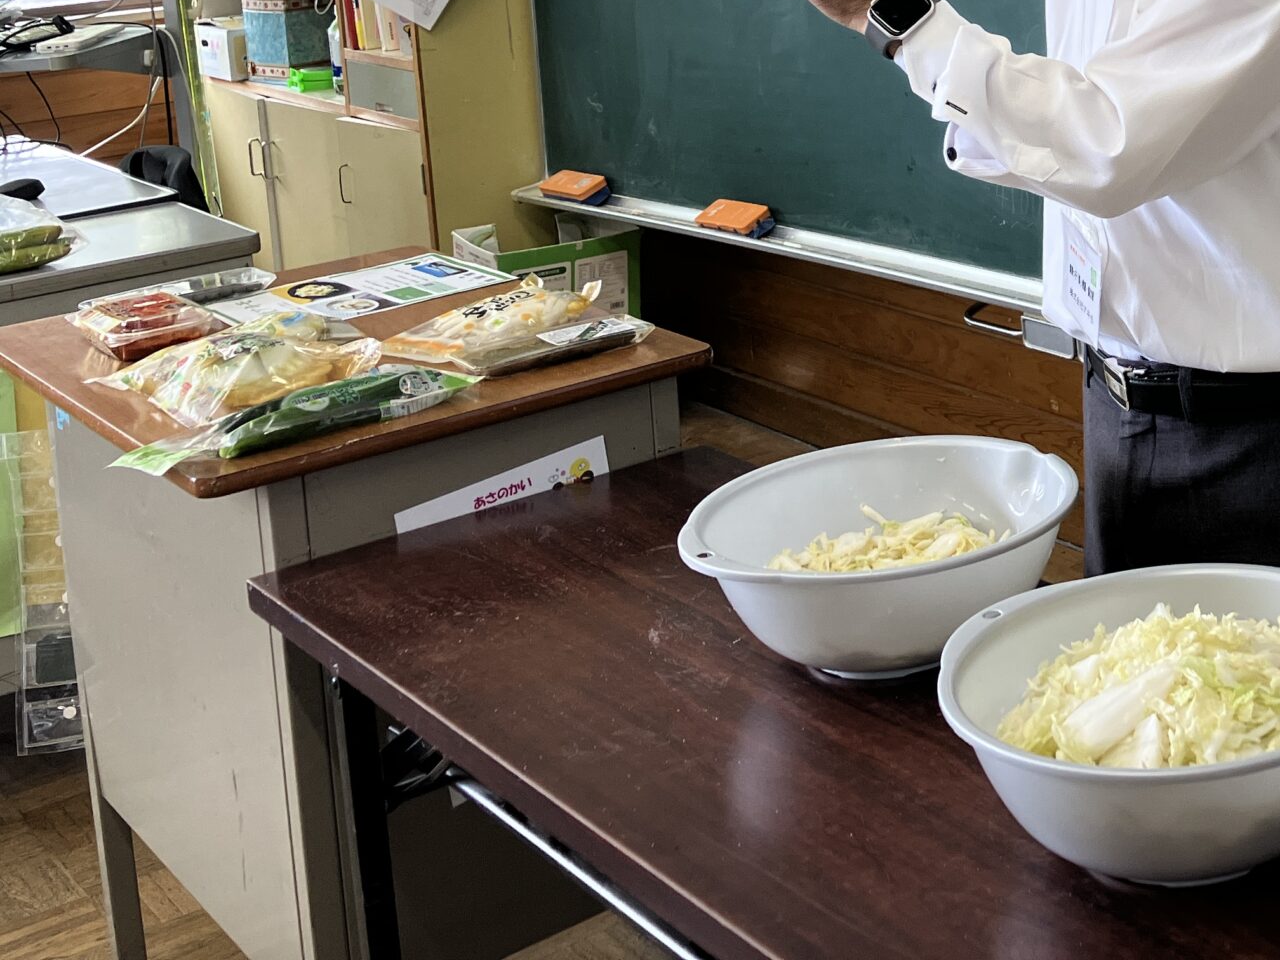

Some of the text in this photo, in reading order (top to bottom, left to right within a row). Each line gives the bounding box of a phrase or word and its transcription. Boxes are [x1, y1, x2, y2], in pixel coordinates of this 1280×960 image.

[473, 477, 533, 510] あさのかい
